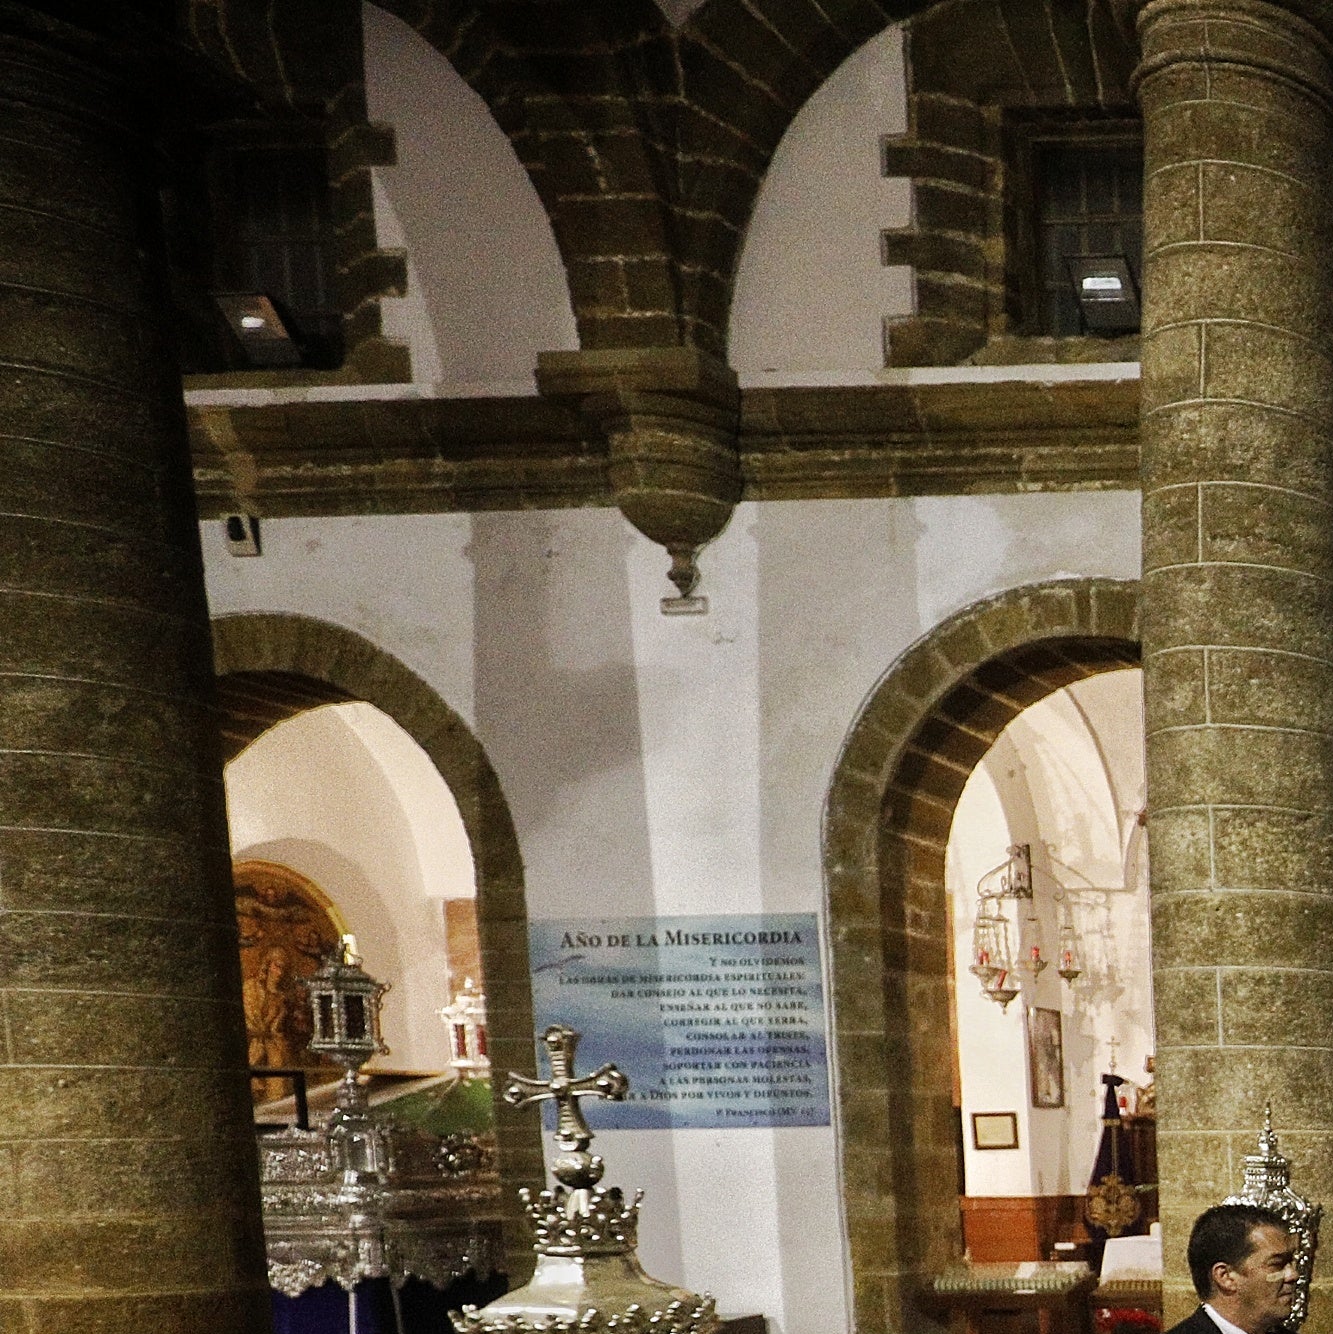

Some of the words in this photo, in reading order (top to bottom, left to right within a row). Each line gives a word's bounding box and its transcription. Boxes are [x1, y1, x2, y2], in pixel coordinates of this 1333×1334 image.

[607, 934, 631, 948] DE
[636, 933, 659, 947] LA
[665, 929, 802, 946] MISERICORDIA
